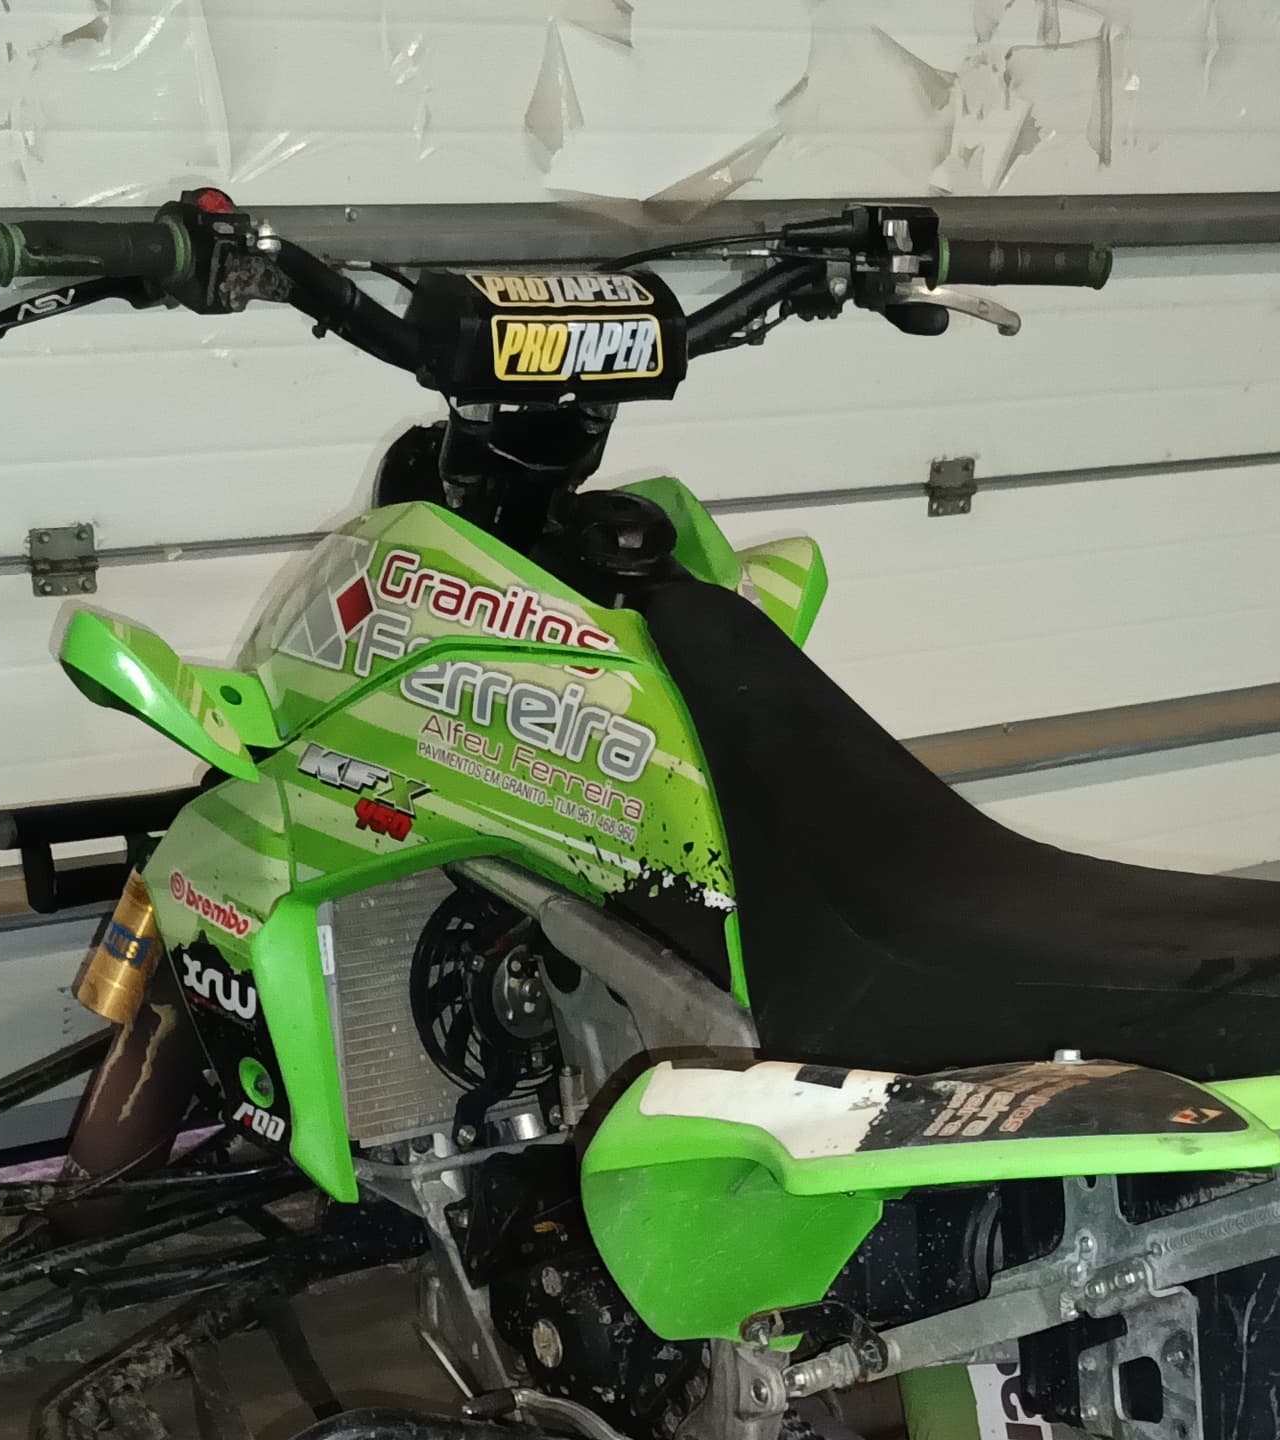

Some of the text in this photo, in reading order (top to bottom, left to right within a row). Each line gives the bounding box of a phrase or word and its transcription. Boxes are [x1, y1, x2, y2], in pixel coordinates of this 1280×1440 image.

[17, 288, 75, 321] ASV
[379, 553, 611, 675] Granitos
[357, 614, 654, 780] Ferreira
[419, 742, 482, 778] PAVIMENTOS
[483, 769, 500, 785] EM
[501, 775, 546, 806] GRANITO
[554, 799, 577, 816] TLM
[421, 714, 643, 820] Alfeu Ferreira
[186, 882, 249, 935] brembo
